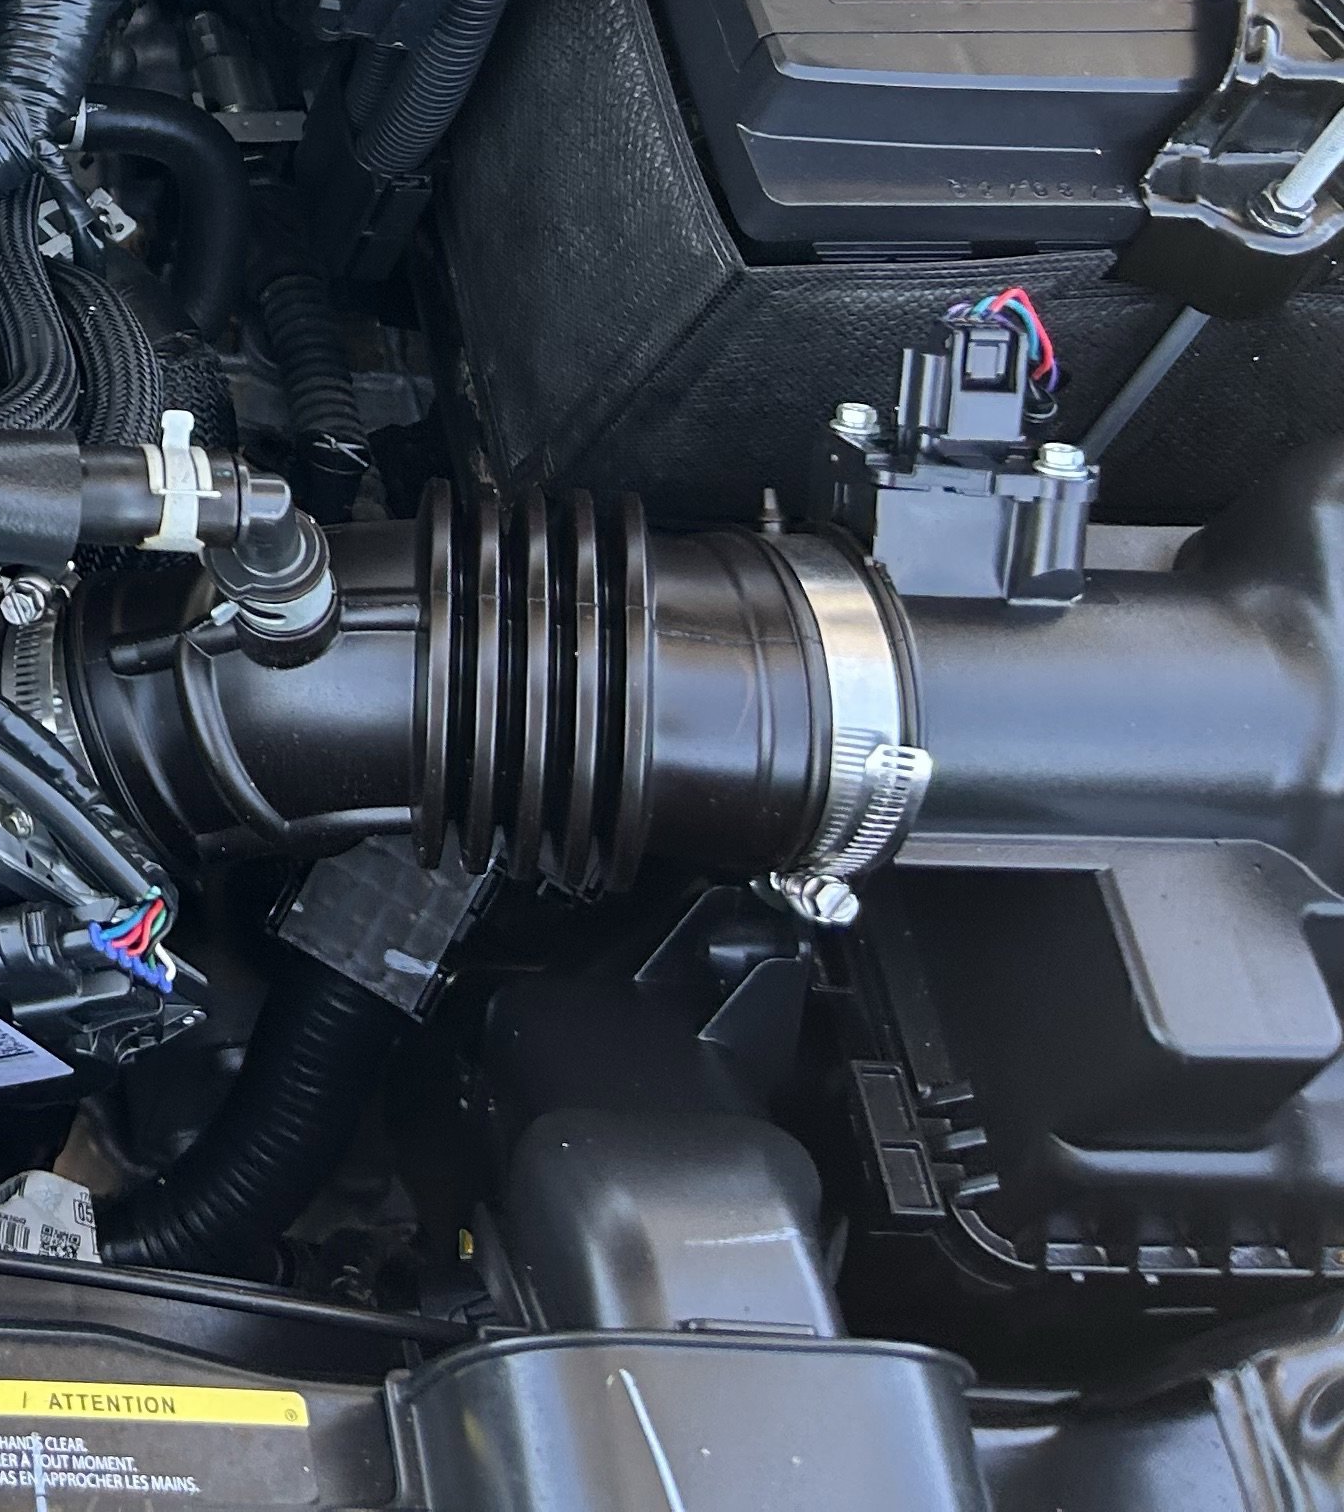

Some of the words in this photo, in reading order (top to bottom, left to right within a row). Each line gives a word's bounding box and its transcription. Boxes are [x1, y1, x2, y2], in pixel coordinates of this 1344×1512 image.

[48, 1392, 177, 1415] ATTENTION
[44, 1437, 88, 1452] CLEAR.
[72, 1456, 138, 1472] MOMENT.
[44, 1473, 123, 1490] APPROCHER
[125, 1475, 149, 1490] LES
[151, 1476, 201, 1493] MAINS.
